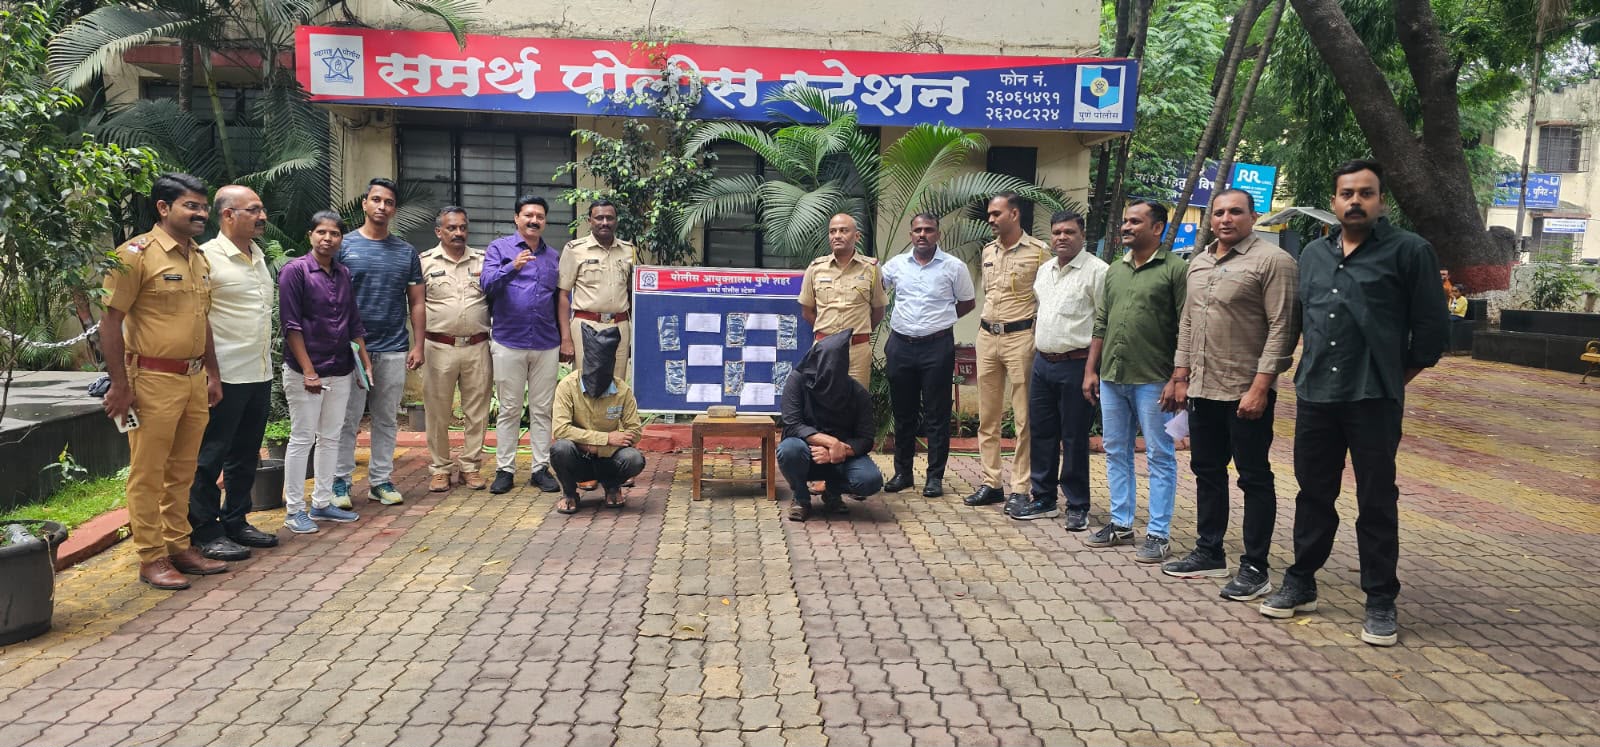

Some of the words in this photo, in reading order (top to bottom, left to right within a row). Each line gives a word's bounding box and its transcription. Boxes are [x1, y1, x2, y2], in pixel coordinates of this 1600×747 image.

[375, 46, 541, 100] समर्थ
[560, 50, 763, 110] पोलीस
[780, 59, 970, 116] स्टेशन
[999, 69, 1029, 87] फोन
[1032, 70, 1048, 87] नं.
[986, 90, 1061, 106] २६०६५४९१
[985, 107, 1060, 122] २६२०८२२४
[1236, 169, 1261, 184] RR
[670, 270, 700, 283] पोलीस
[703, 273, 752, 287] आयुक्तालय
[755, 273, 770, 288] पुणे
[772, 276, 791, 286] शहर
